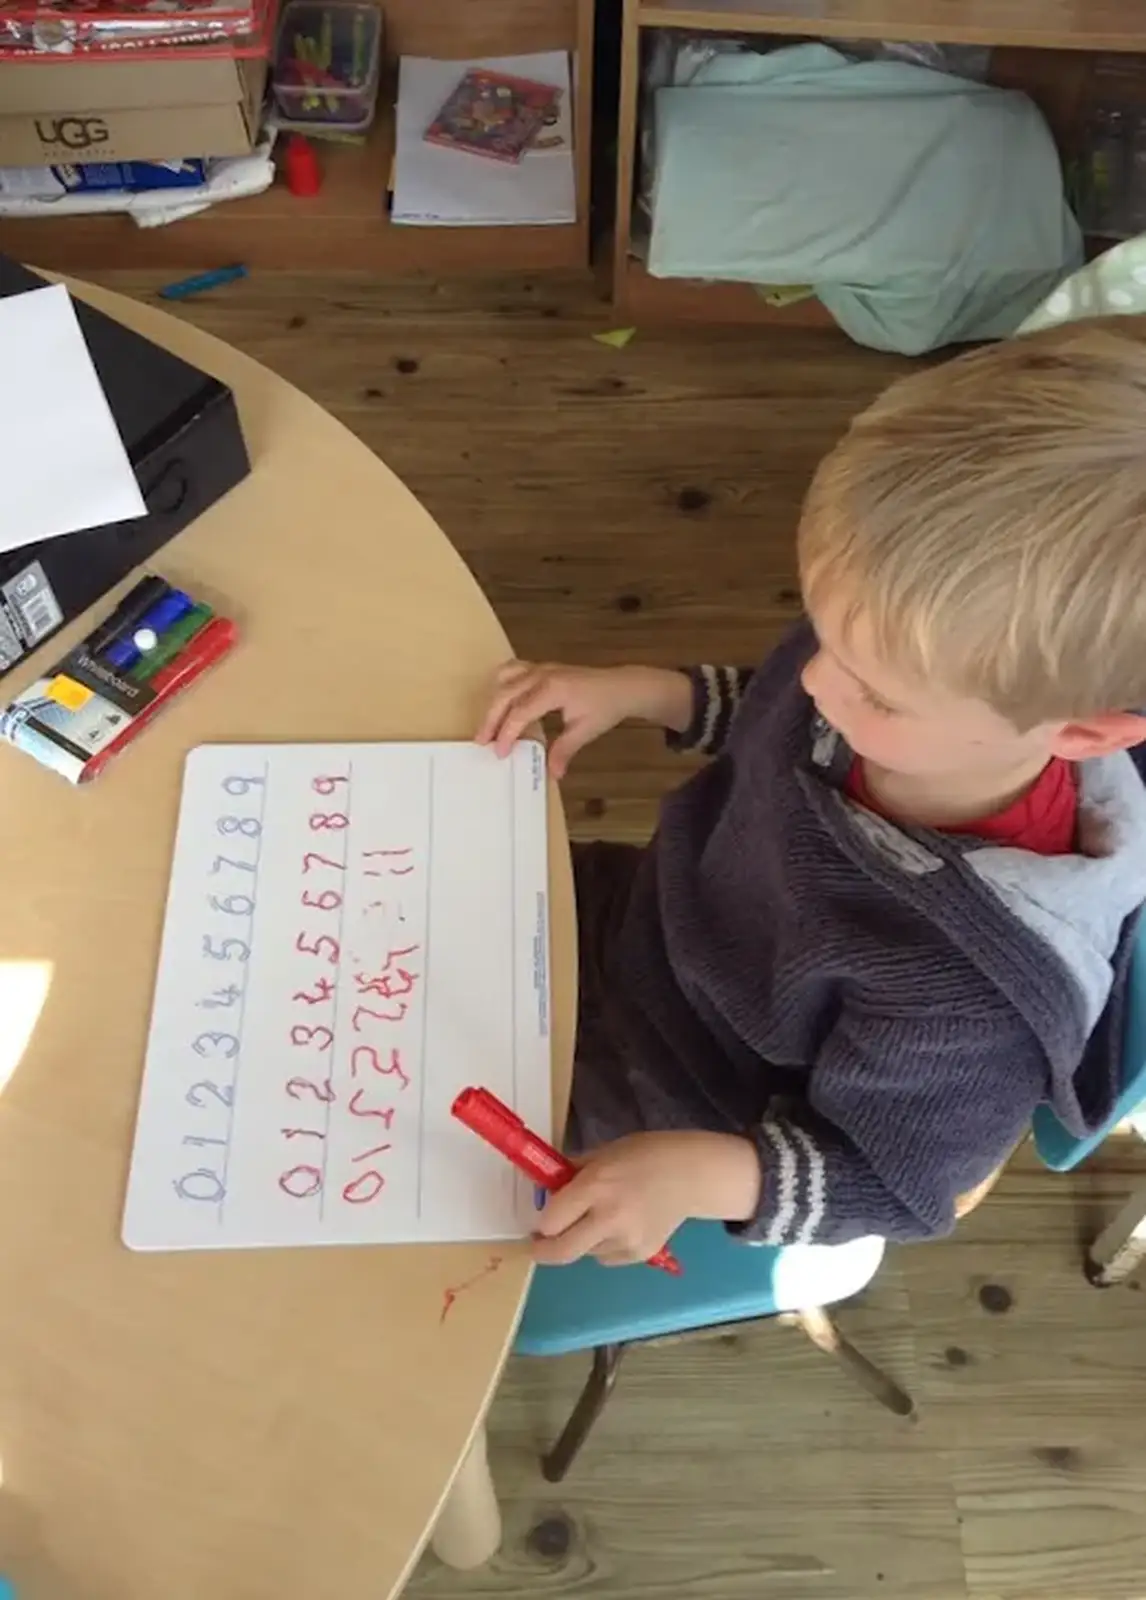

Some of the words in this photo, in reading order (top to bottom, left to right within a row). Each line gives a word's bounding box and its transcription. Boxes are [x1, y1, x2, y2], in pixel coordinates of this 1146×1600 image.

[34, 117, 109, 149] UGG
[221, 776, 266, 796] 9
[312, 776, 350, 796] 9
[216, 815, 263, 839] 8
[308, 812, 350, 831] 8
[207, 855, 258, 875] 7
[302, 852, 348, 875] 7
[207, 893, 256, 916] 6
[301, 890, 343, 911] 6
[202, 934, 252, 962] 5
[296, 931, 340, 965] 5
[195, 984, 242, 1008] 4
[291, 977, 337, 1005] 4
[192, 1031, 241, 1059] 3
[290, 1024, 334, 1052] 3
[185, 1079, 235, 1108] 2
[285, 1076, 336, 1105] 2
[182, 1135, 228, 1147] 1
[279, 1127, 327, 1140] 1
[172, 1167, 227, 1203] 0
[278, 1164, 324, 1199] 0
